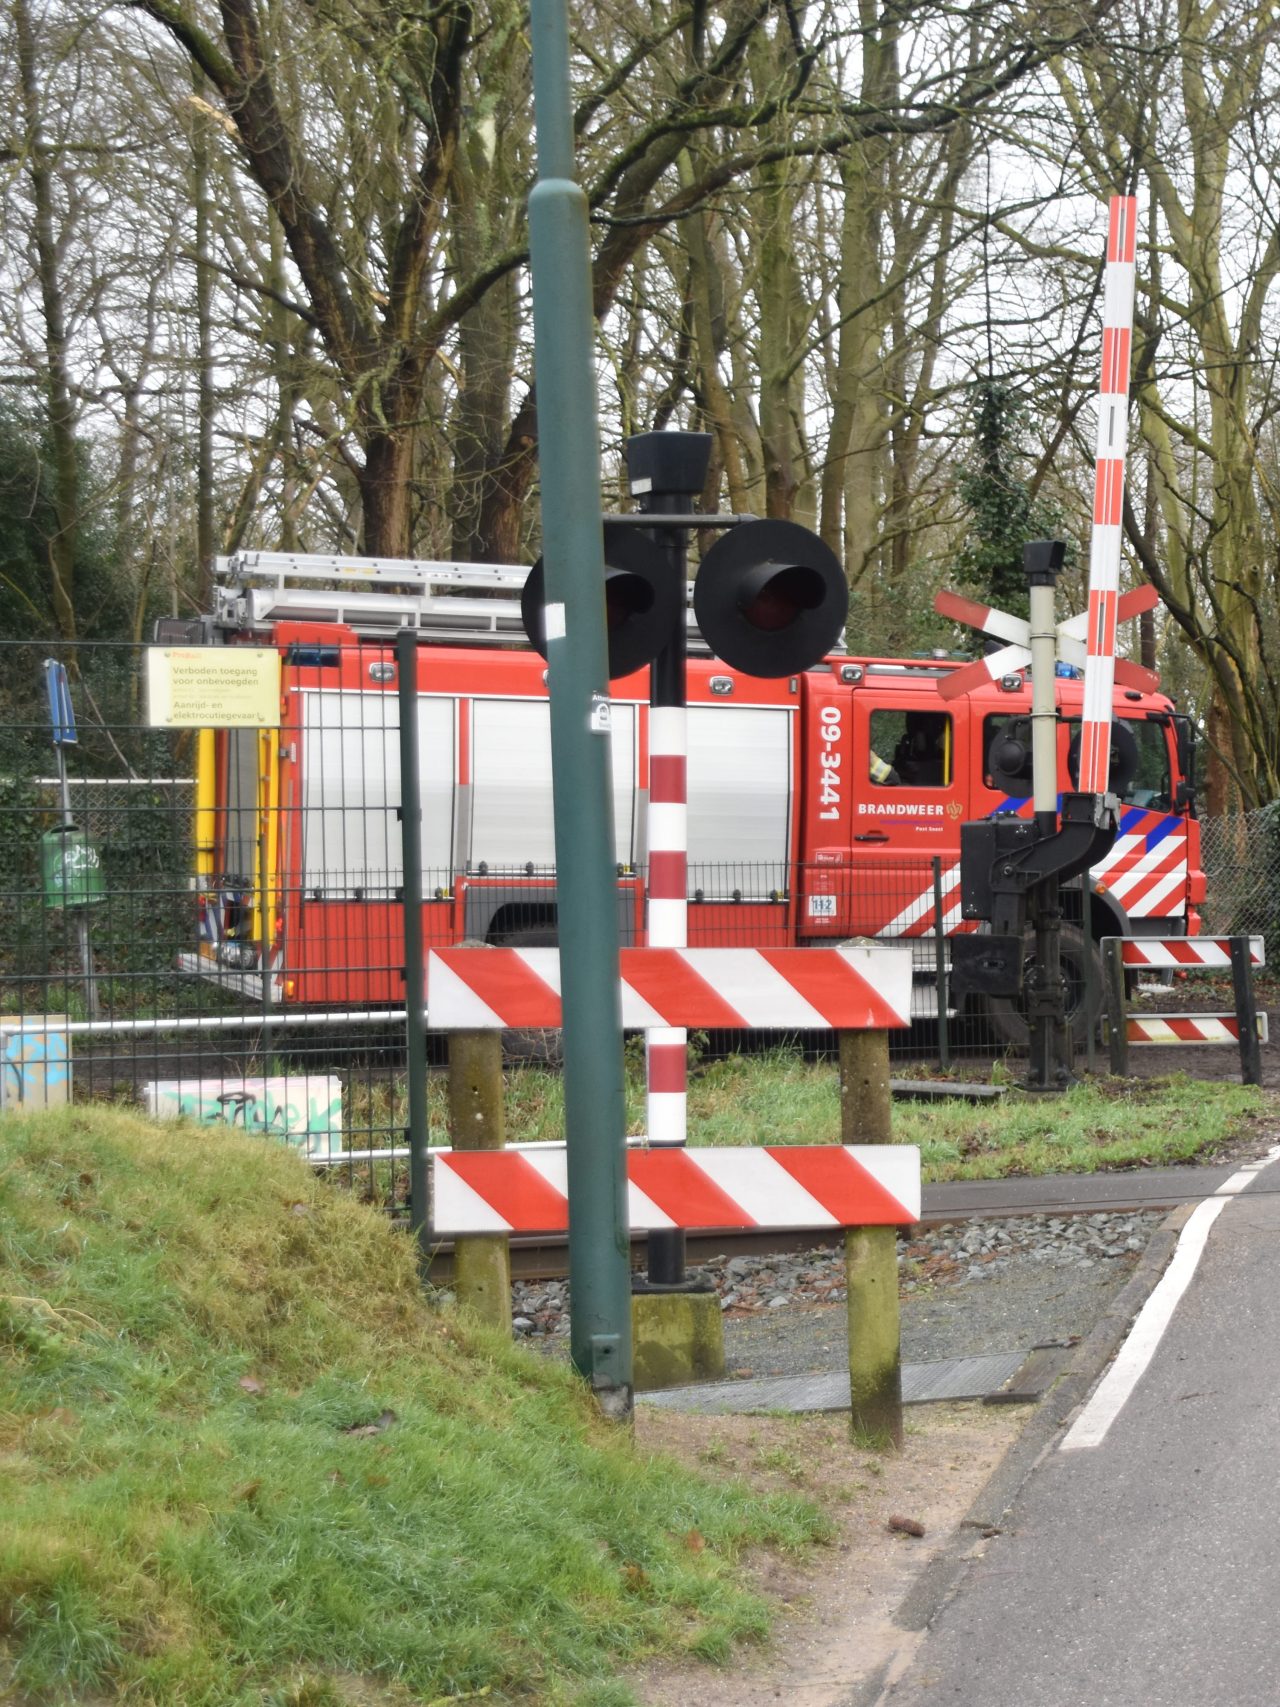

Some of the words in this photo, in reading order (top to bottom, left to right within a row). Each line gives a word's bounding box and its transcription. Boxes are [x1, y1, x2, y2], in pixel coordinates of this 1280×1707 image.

[173, 666, 218, 675] Verboden
[220, 667, 258, 677] toegang
[196, 677, 259, 687] onbevoegden
[173, 701, 210, 710] Aanrijd-
[819, 706, 842, 820] 09-3441
[858, 803, 944, 816] BRANDWEER
[813, 899, 832, 910] 112
